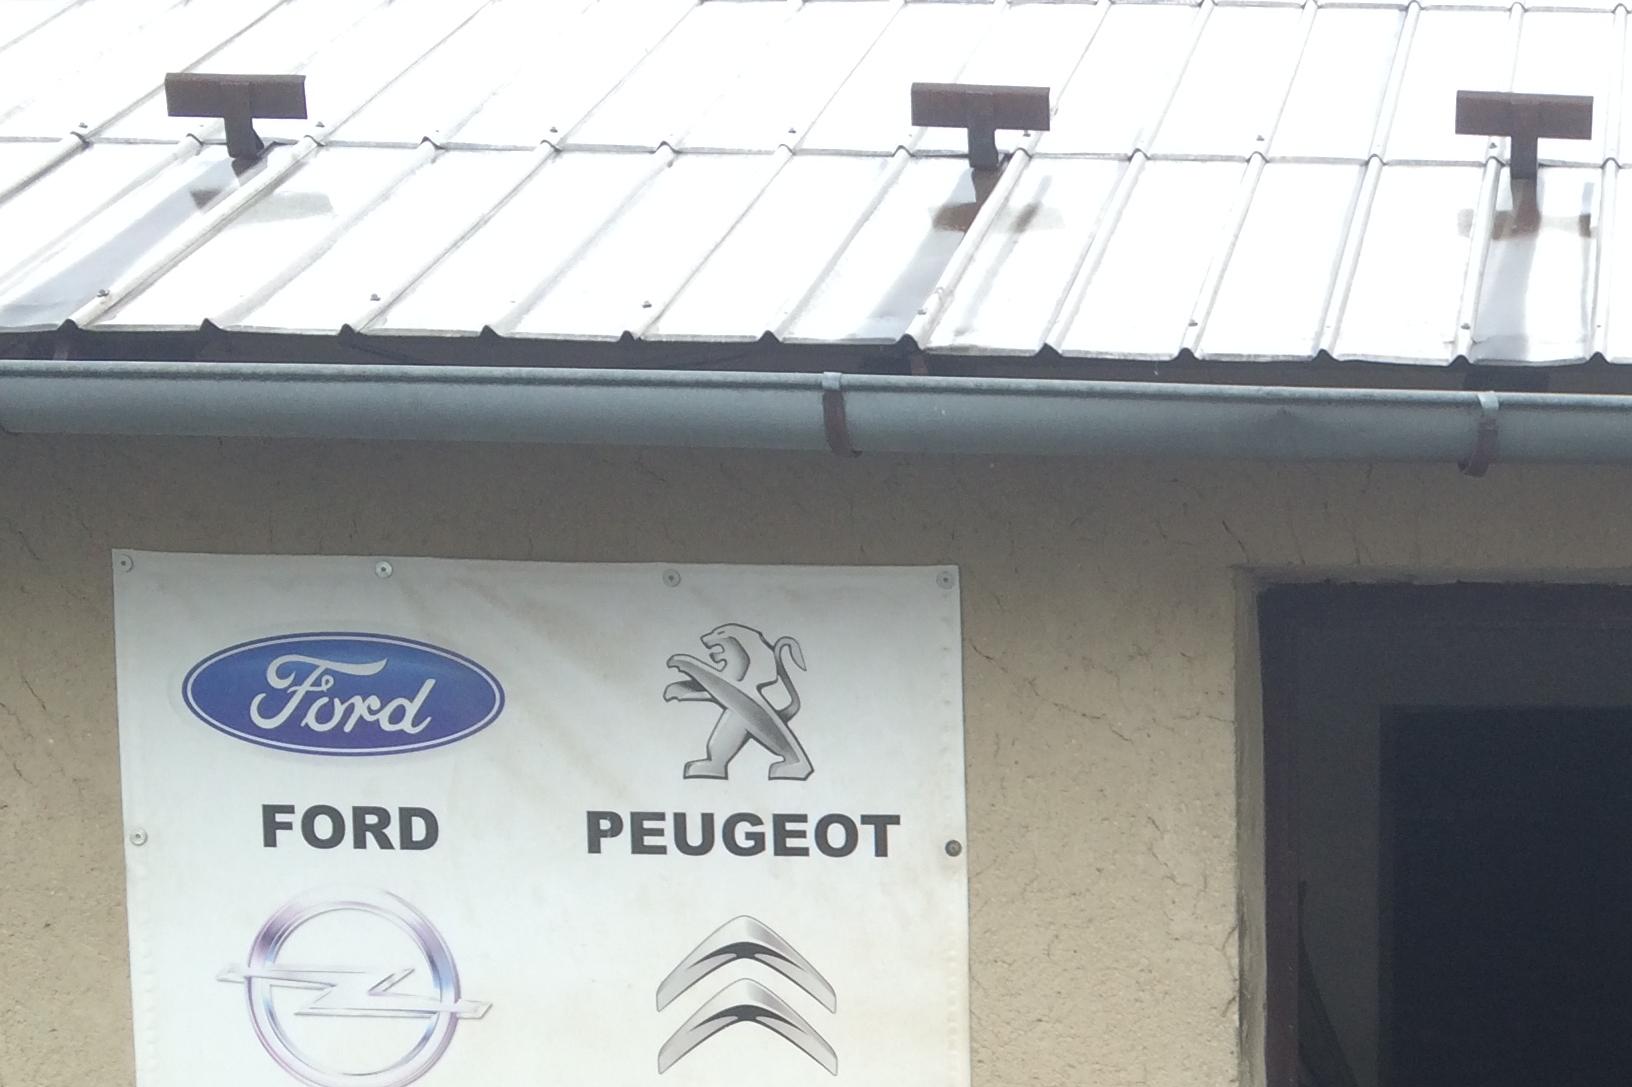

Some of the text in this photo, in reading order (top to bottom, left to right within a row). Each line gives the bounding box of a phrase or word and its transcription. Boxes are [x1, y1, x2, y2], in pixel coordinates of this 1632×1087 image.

[249, 653, 434, 737] Ford
[262, 804, 438, 850] FORD
[587, 811, 900, 857] PEUGEOT
